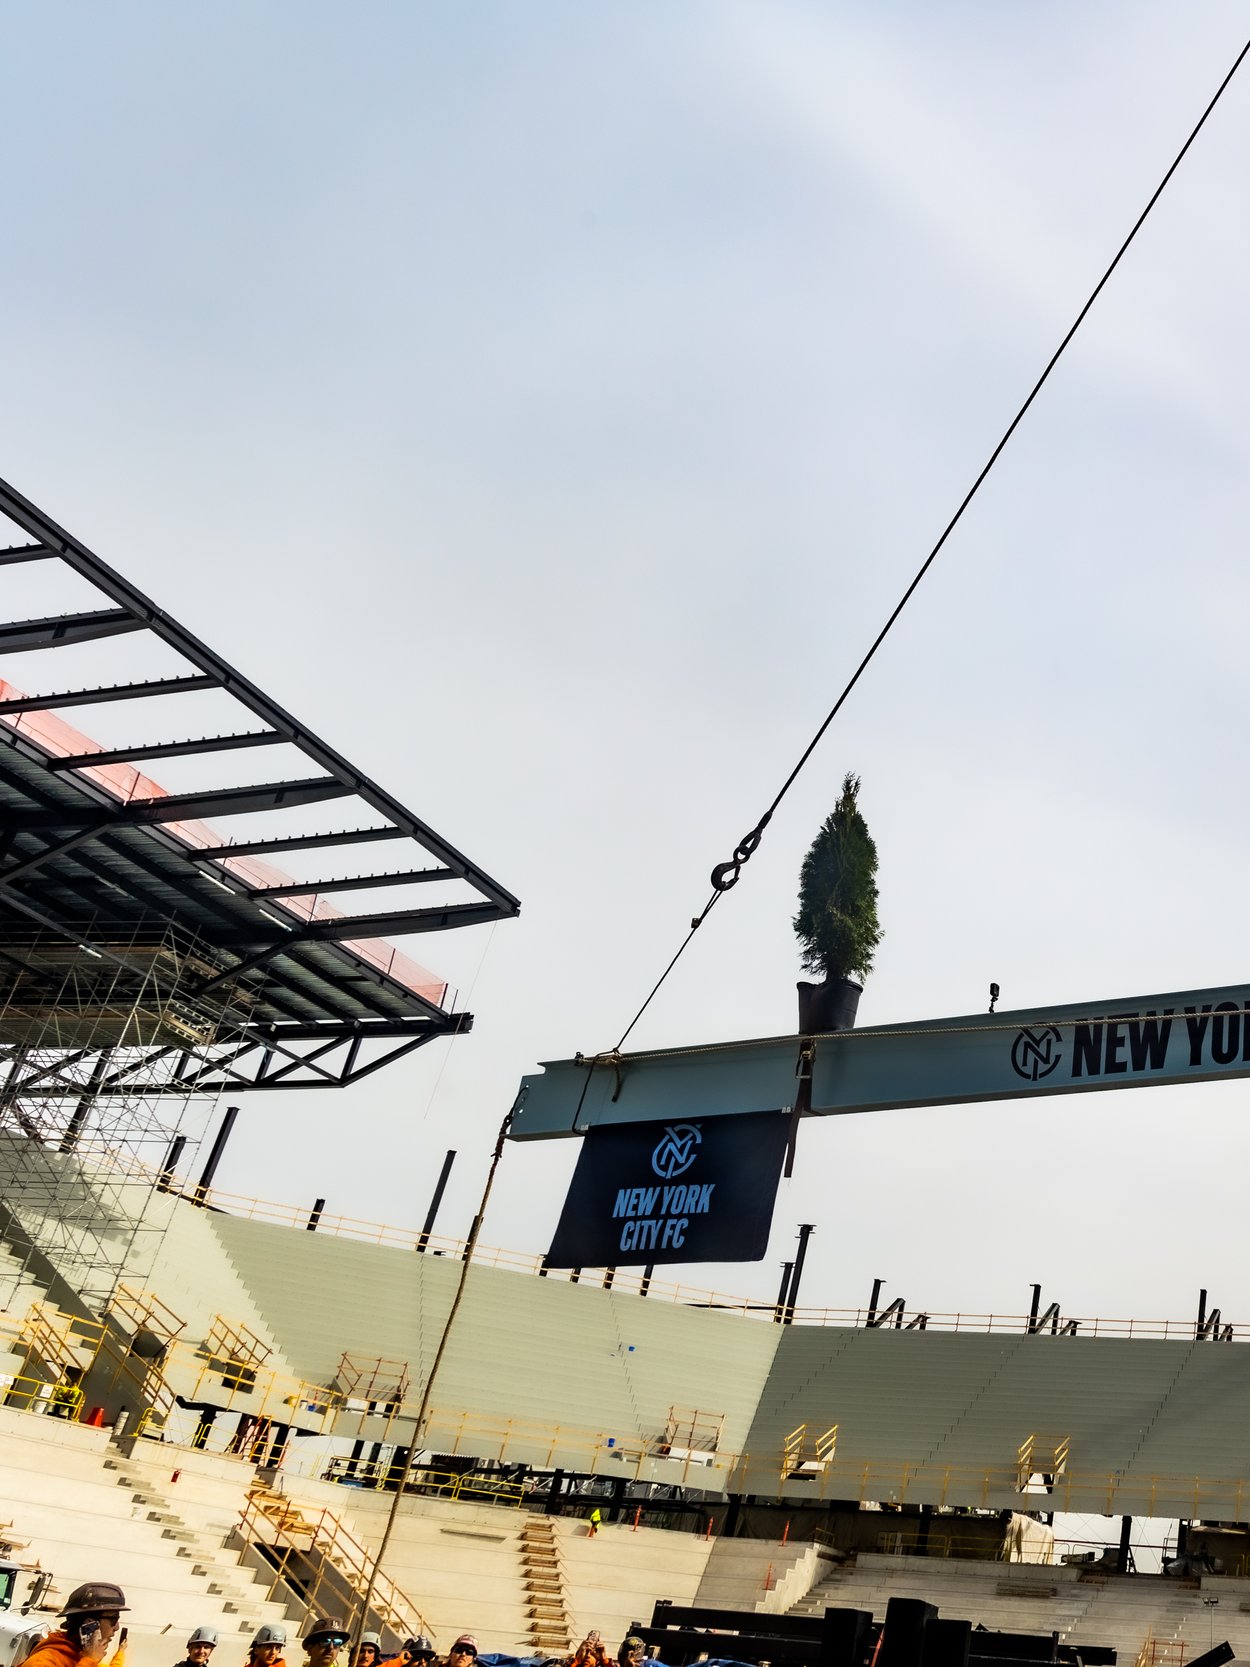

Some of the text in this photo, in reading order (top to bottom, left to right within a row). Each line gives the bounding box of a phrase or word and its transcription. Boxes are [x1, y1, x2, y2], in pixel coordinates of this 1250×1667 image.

[1071, 1009, 1173, 1077] NEW
[612, 1184, 716, 1218] NEW YORK
[620, 1218, 689, 1251] CITY FC
